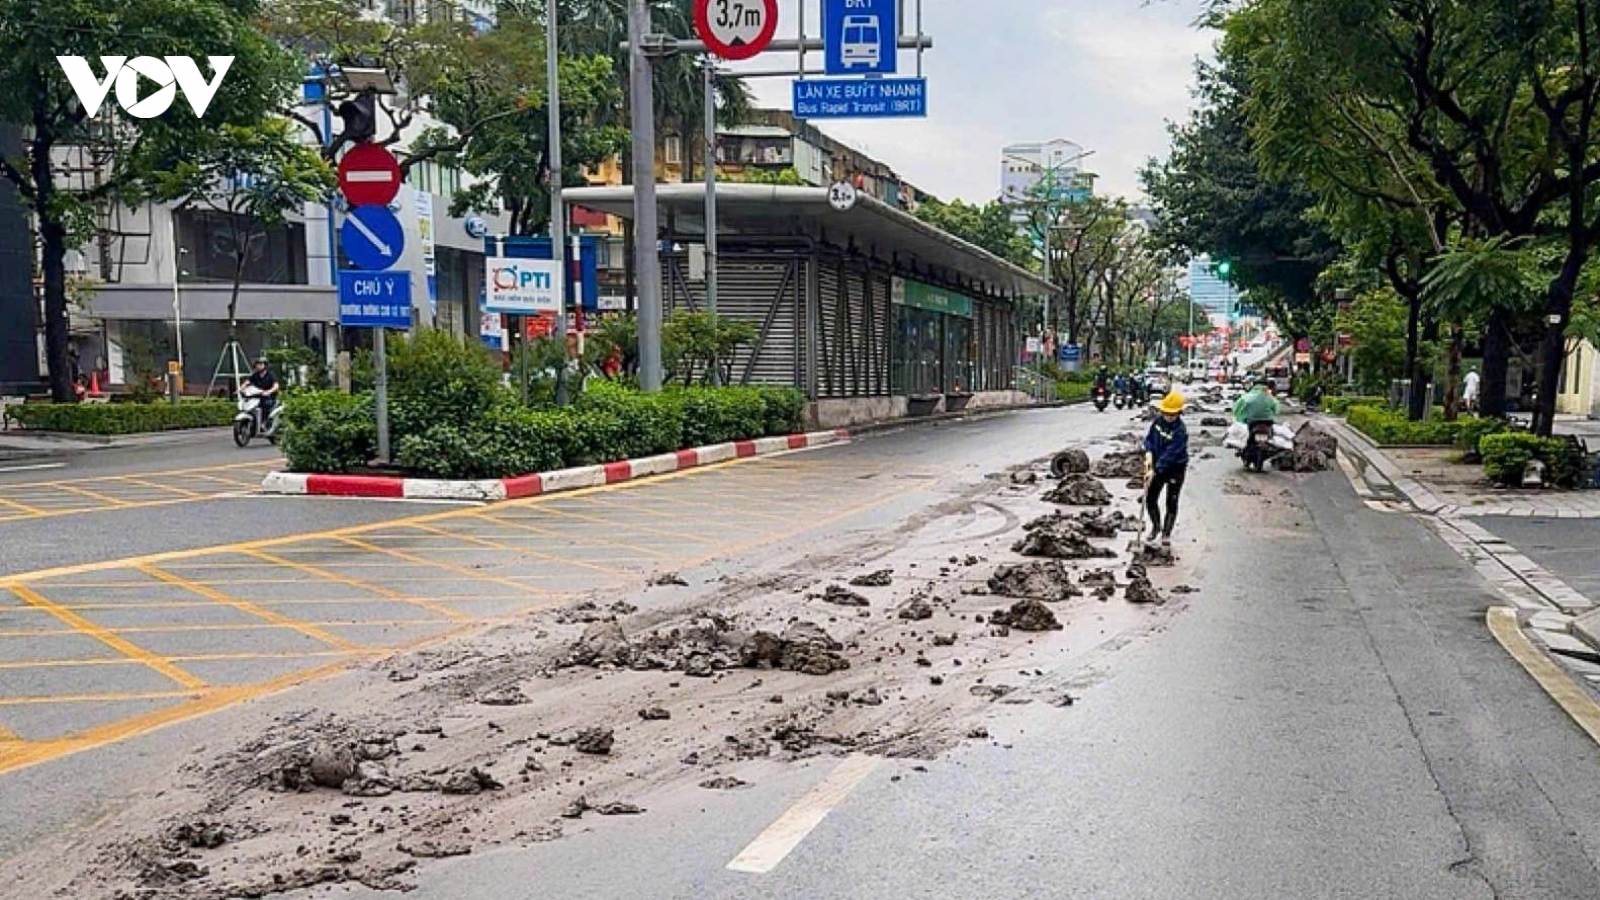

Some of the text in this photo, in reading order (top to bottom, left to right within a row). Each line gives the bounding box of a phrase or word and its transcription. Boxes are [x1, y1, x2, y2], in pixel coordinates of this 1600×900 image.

[716, 0, 760, 29] 3,7m
[826, 85, 841, 98] XE
[844, 82, 876, 98] BUÝT
[880, 84, 922, 97] NHANH
[797, 99, 921, 114] Bus Rapid Transit (BRT)
[354, 277, 394, 295] CHÚ Ý
[520, 271, 550, 289] PTI
